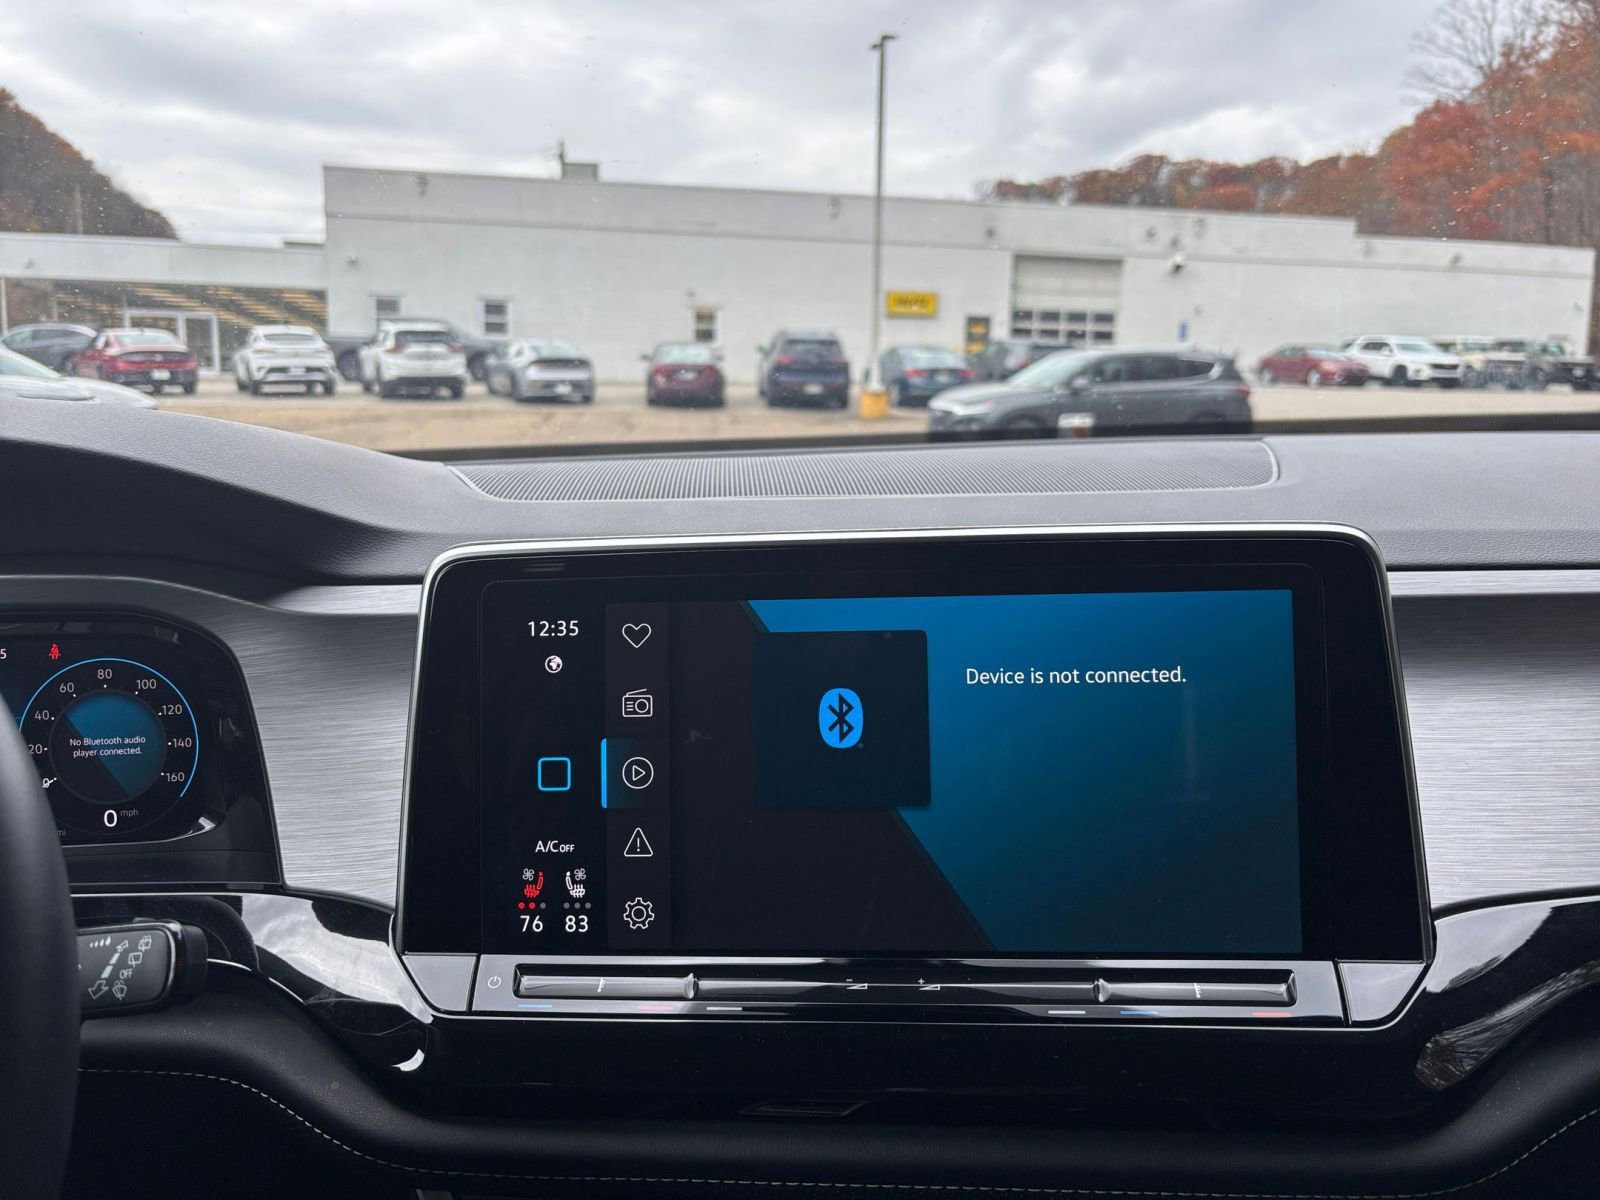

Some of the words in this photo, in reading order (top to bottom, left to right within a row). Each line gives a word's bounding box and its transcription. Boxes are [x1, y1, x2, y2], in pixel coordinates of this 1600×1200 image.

[528, 620, 579, 637] 12:35
[97, 668, 113, 680] 80
[966, 668, 1025, 685] Device
[1030, 667, 1044, 684] is
[1050, 668, 1080, 684] not
[1085, 666, 1187, 684] connected.
[59, 682, 75, 693] 60
[136, 678, 157, 690] 100
[34, 709, 50, 721] 40
[162, 704, 183, 715] 120
[69, 738, 82, 747] No
[83, 736, 122, 746] Bluetooth
[123, 735, 146, 744] audio
[172, 737, 192, 748] 140
[28, 743, 43, 755] 20
[73, 748, 97, 759] player
[99, 746, 143, 756] connected.
[165, 771, 185, 783] 160
[103, 809, 118, 828] 0
[120, 808, 139, 818] mph
[520, 915, 544, 933] 76
[564, 915, 589, 933] 83
[119, 968, 134, 979] OFF
